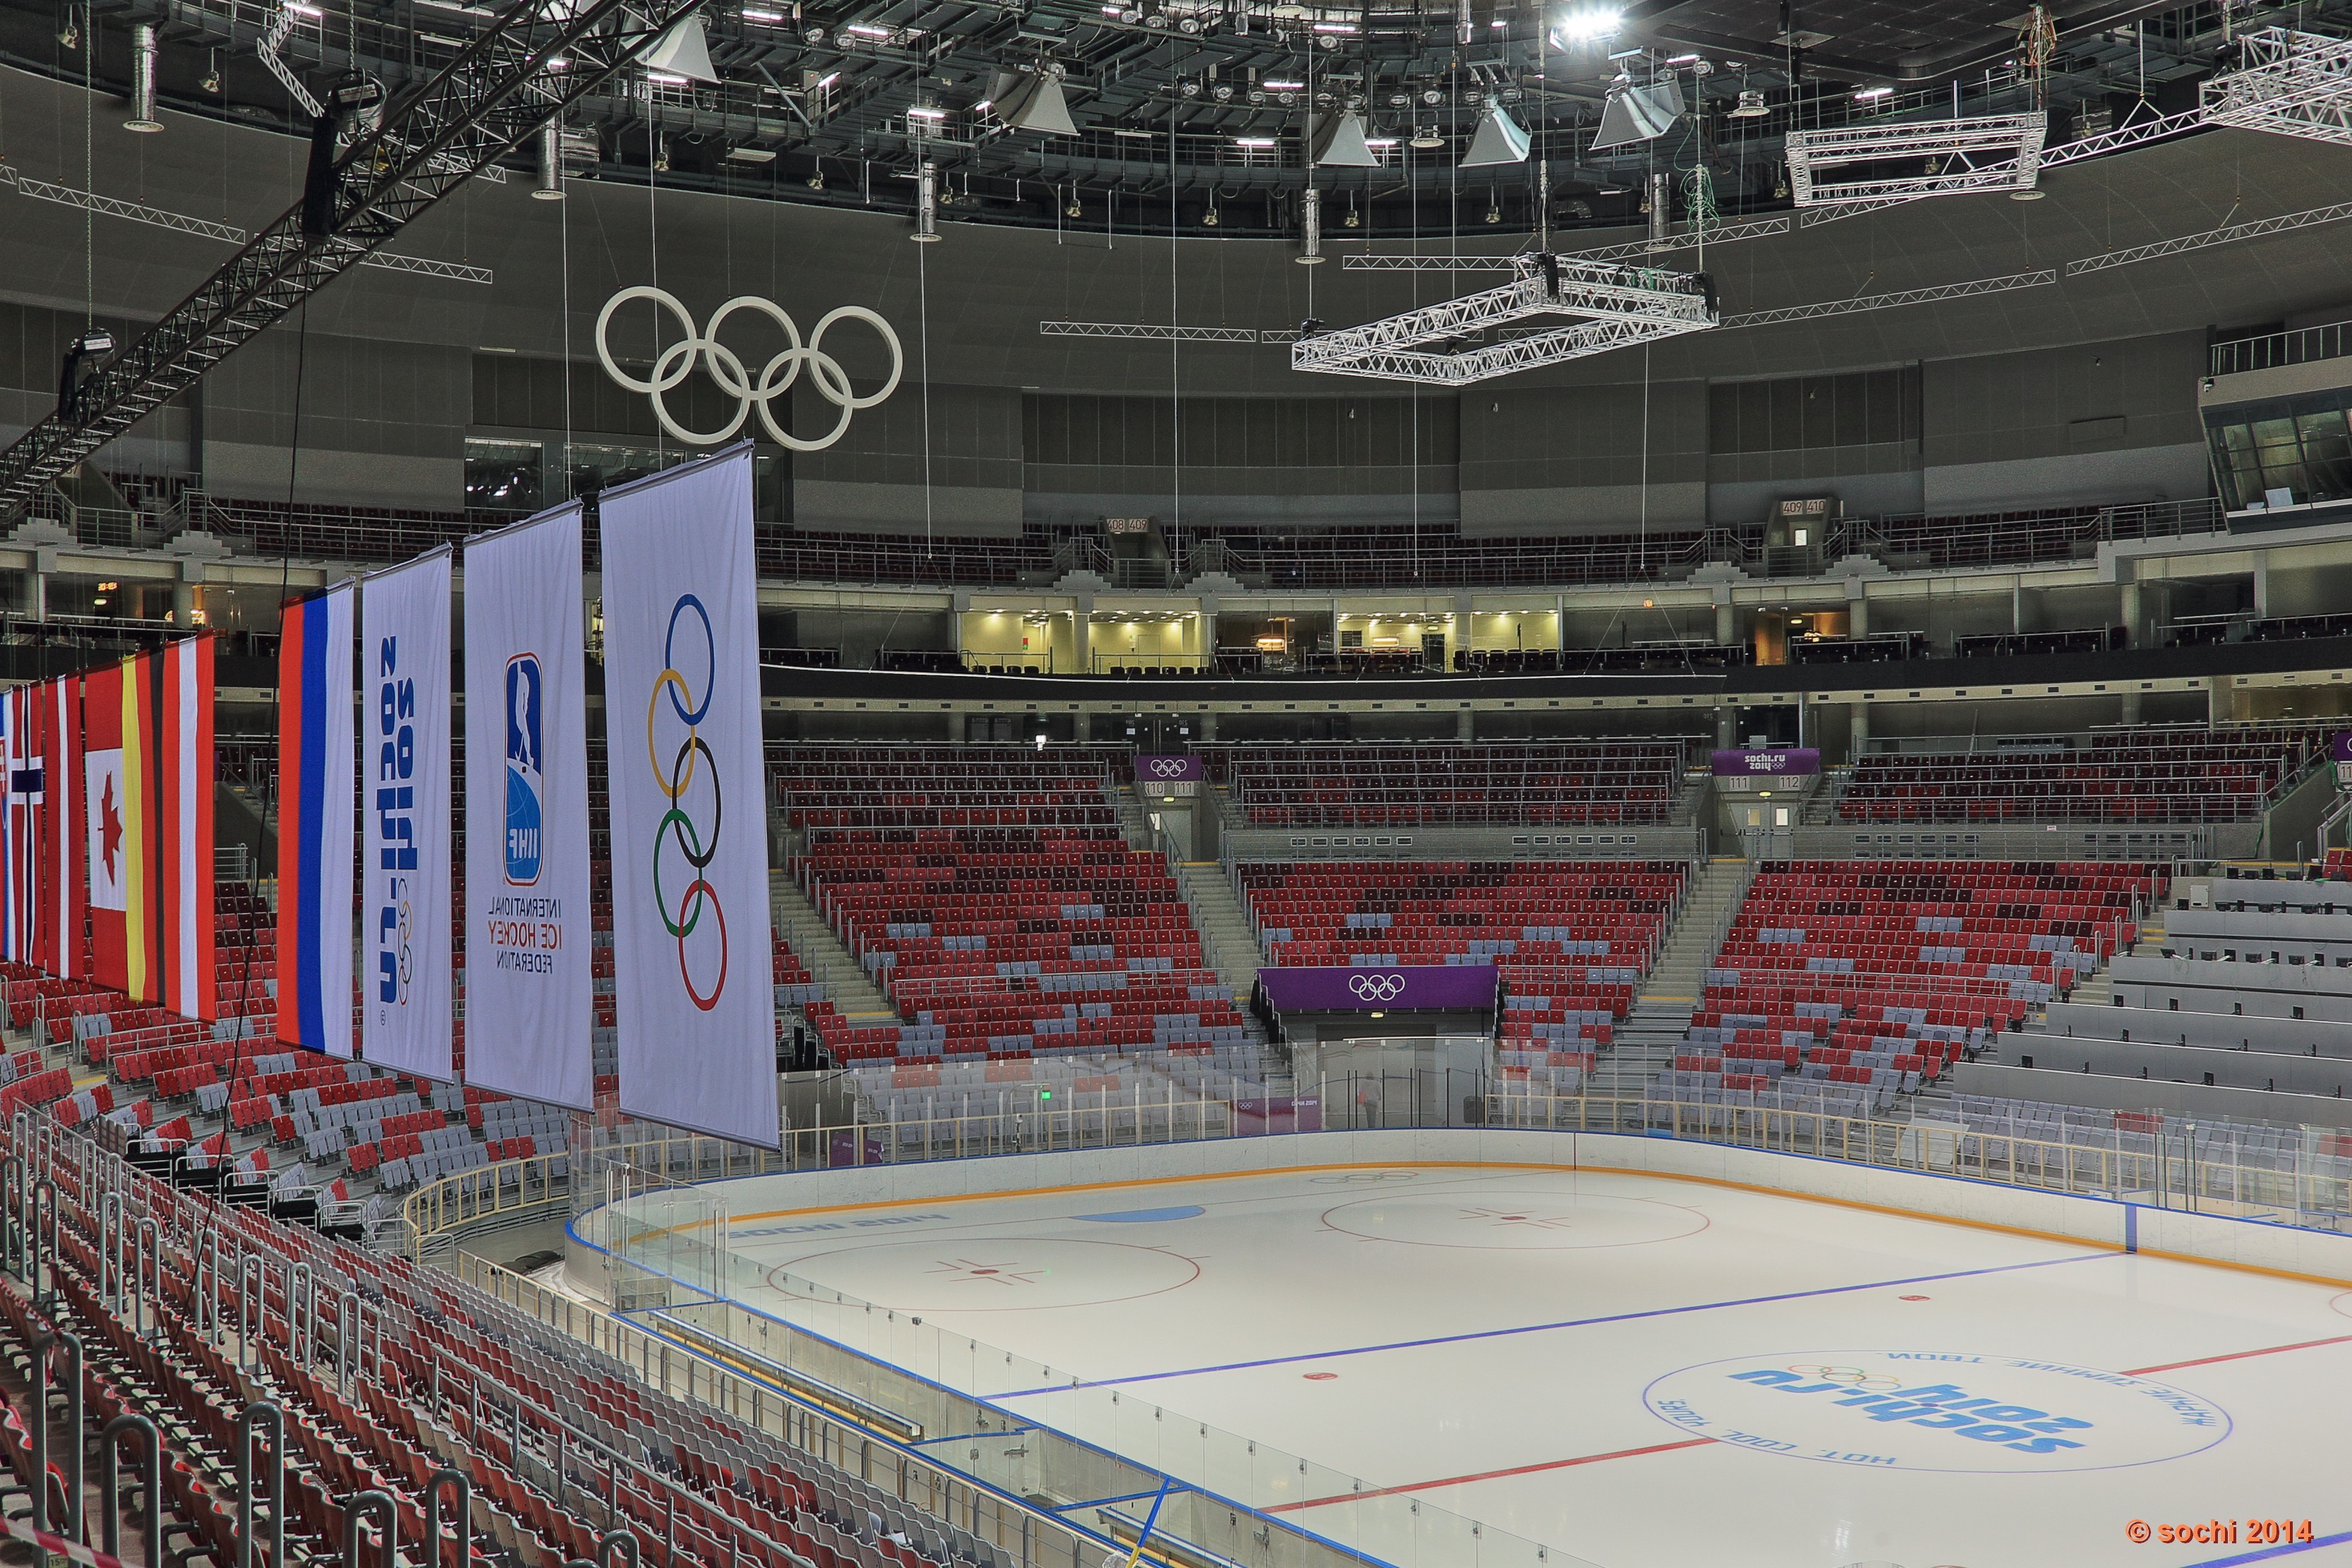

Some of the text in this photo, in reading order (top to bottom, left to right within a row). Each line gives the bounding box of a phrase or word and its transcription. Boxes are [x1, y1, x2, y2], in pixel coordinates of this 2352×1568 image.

[1783, 502, 1802, 512] 409
[1807, 500, 1825, 512] 410
[1108, 519, 1124, 530] 408
[1130, 519, 1147, 530] 409
[1744, 753, 1785, 763] sochi.ru
[1749, 762, 1771, 771] 2014
[2341, 766, 2352, 778] 11
[1146, 783, 1164, 793] 110
[1175, 783, 1192, 793] 111
[1730, 778, 1748, 788] 111
[1780, 777, 1799, 788] 112
[718, 1214, 951, 1239] SOCHI 2014
[1657, 1399, 1897, 1465] HOT. COOL. YOURS.
